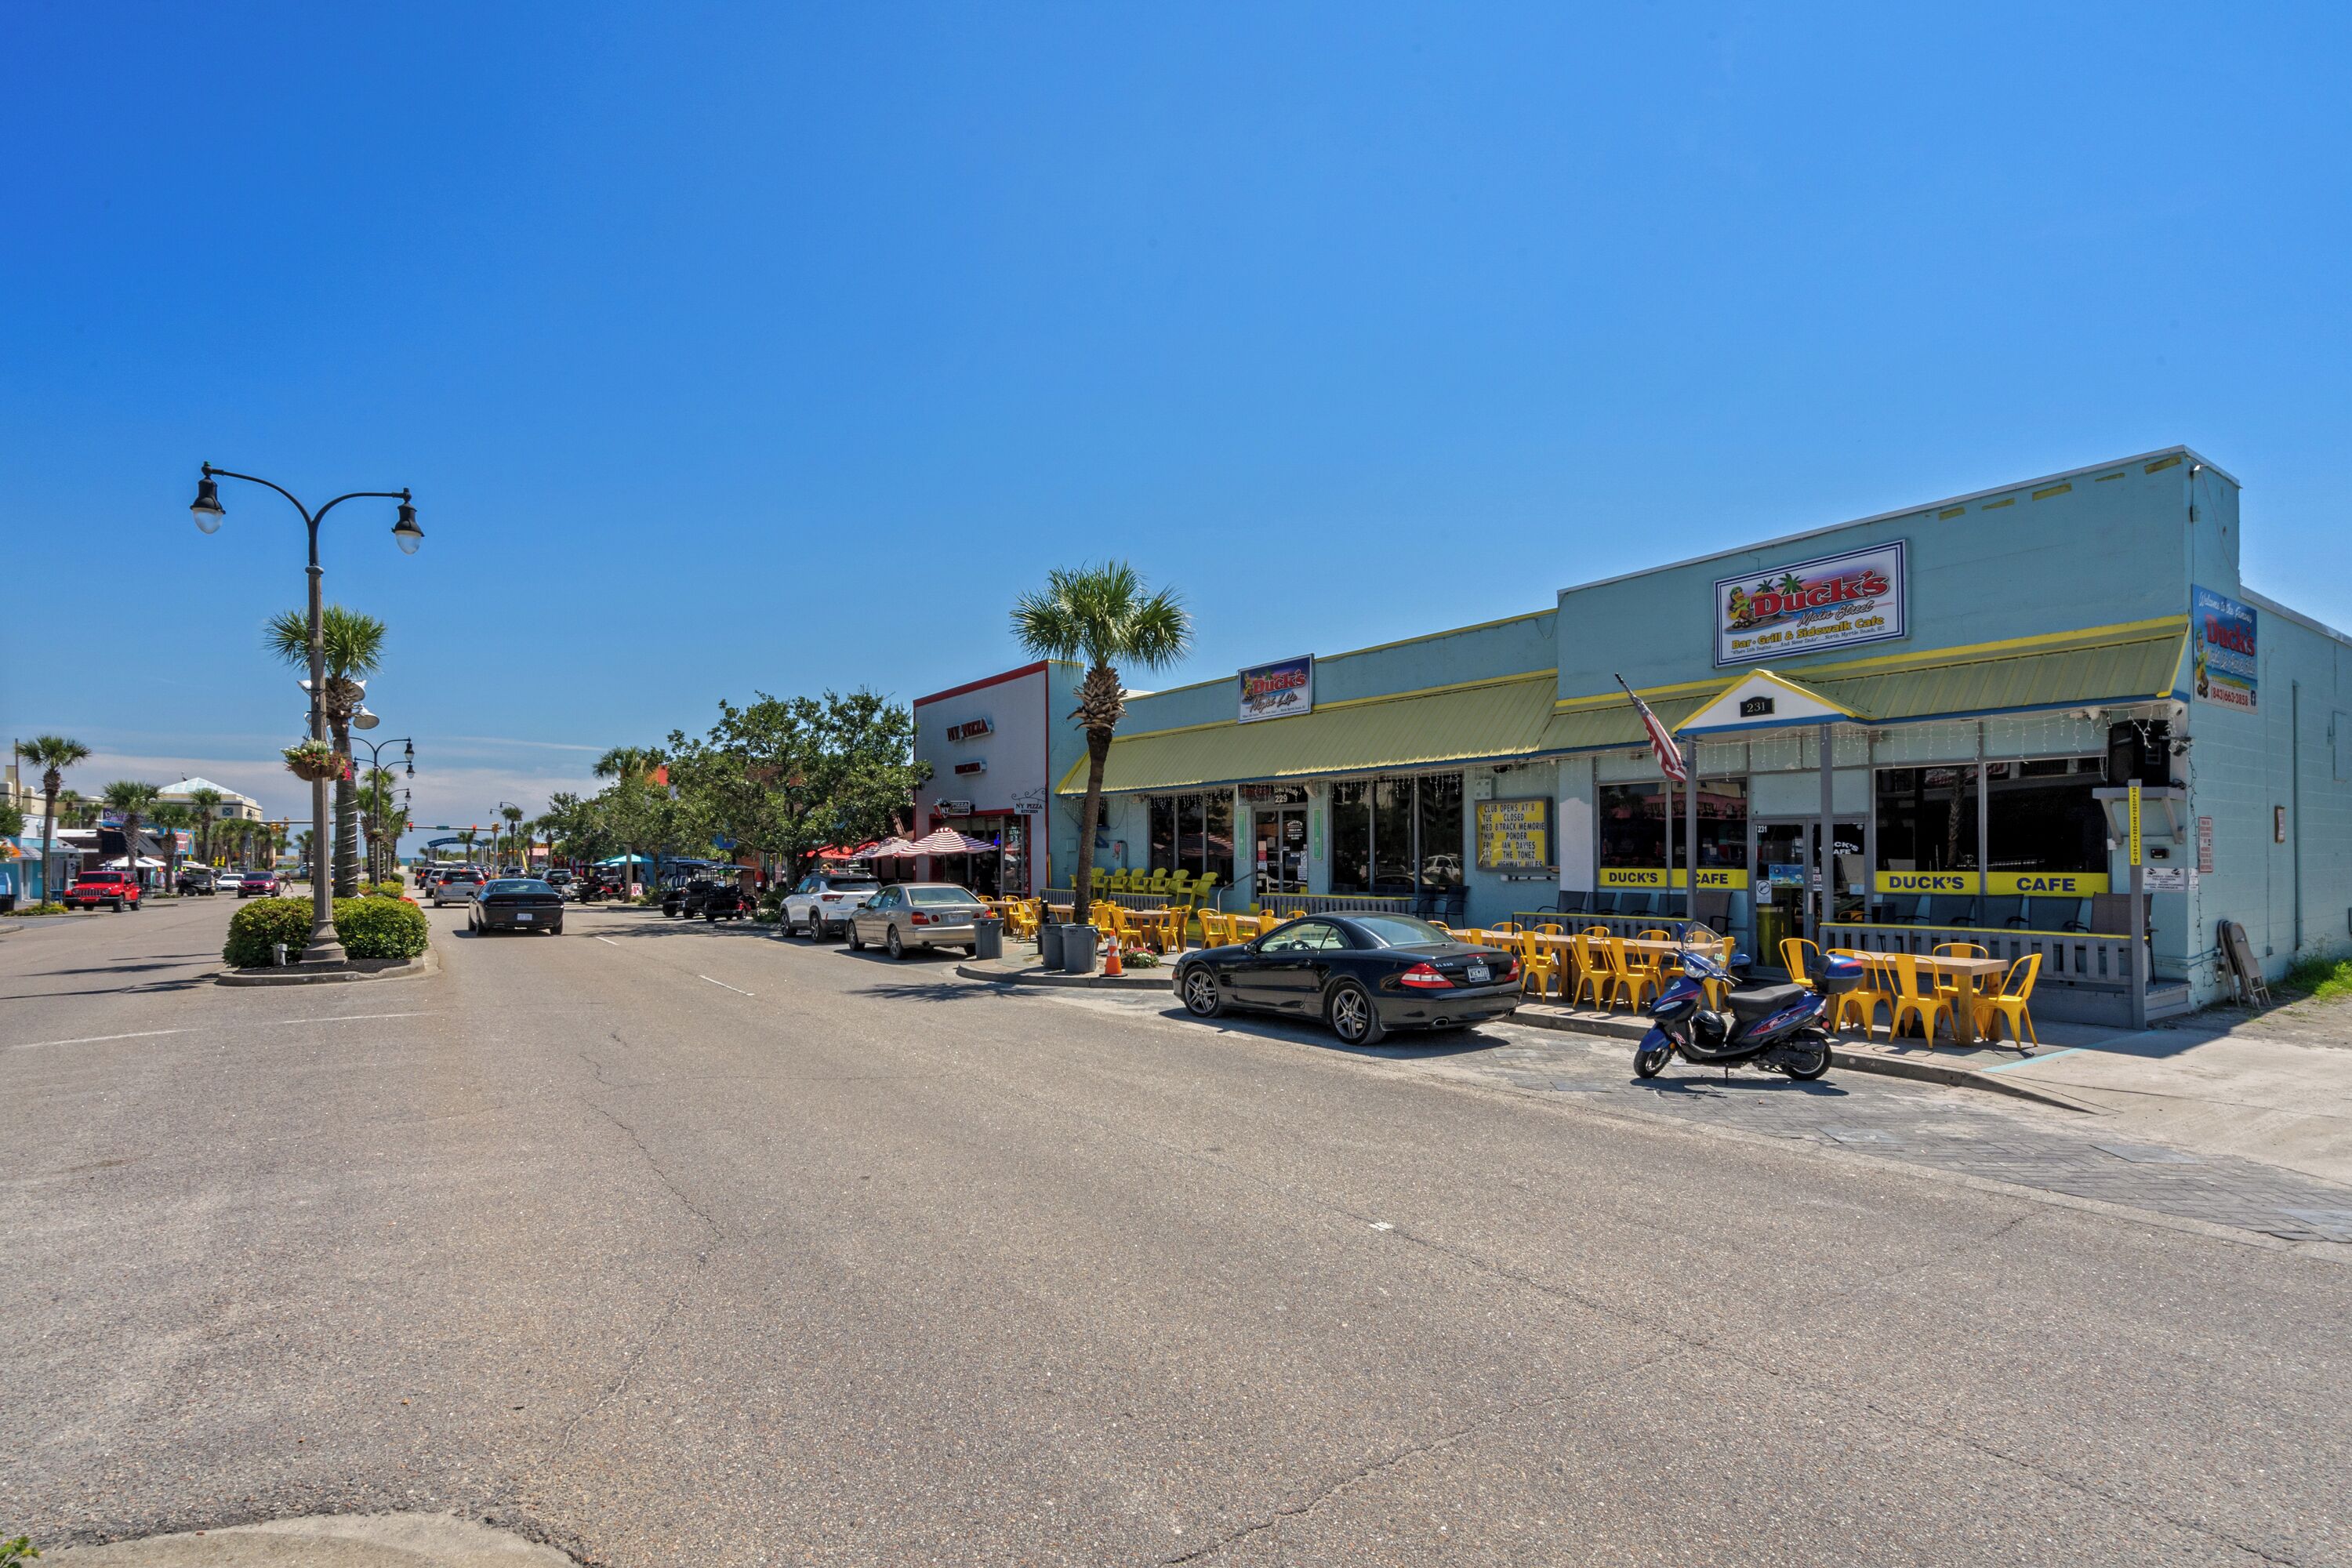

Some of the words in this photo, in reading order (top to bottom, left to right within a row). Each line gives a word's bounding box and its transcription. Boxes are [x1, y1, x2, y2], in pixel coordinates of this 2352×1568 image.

[1749, 568, 1890, 619] Duck's
[1796, 610, 1834, 627] Main
[1835, 600, 1875, 620] Street
[1731, 640, 1751, 650] Bar
[1757, 632, 1782, 645] Grill
[1784, 630, 1794, 641] &
[1796, 621, 1853, 639] Sidewalk
[1855, 615, 1885, 628] Cafe
[2205, 614, 2256, 657] Duck's
[1253, 669, 1307, 695] Duck's
[1747, 702, 1766, 713] 231
[1275, 793, 1287, 803] 229
[1500, 804, 1518, 812] OPENS
[1506, 832, 1527, 840] PONDER
[1609, 873, 1658, 884] DUCK'S
[1889, 876, 1965, 889] DUCK'S
[2016, 877, 2077, 892] CAFE
